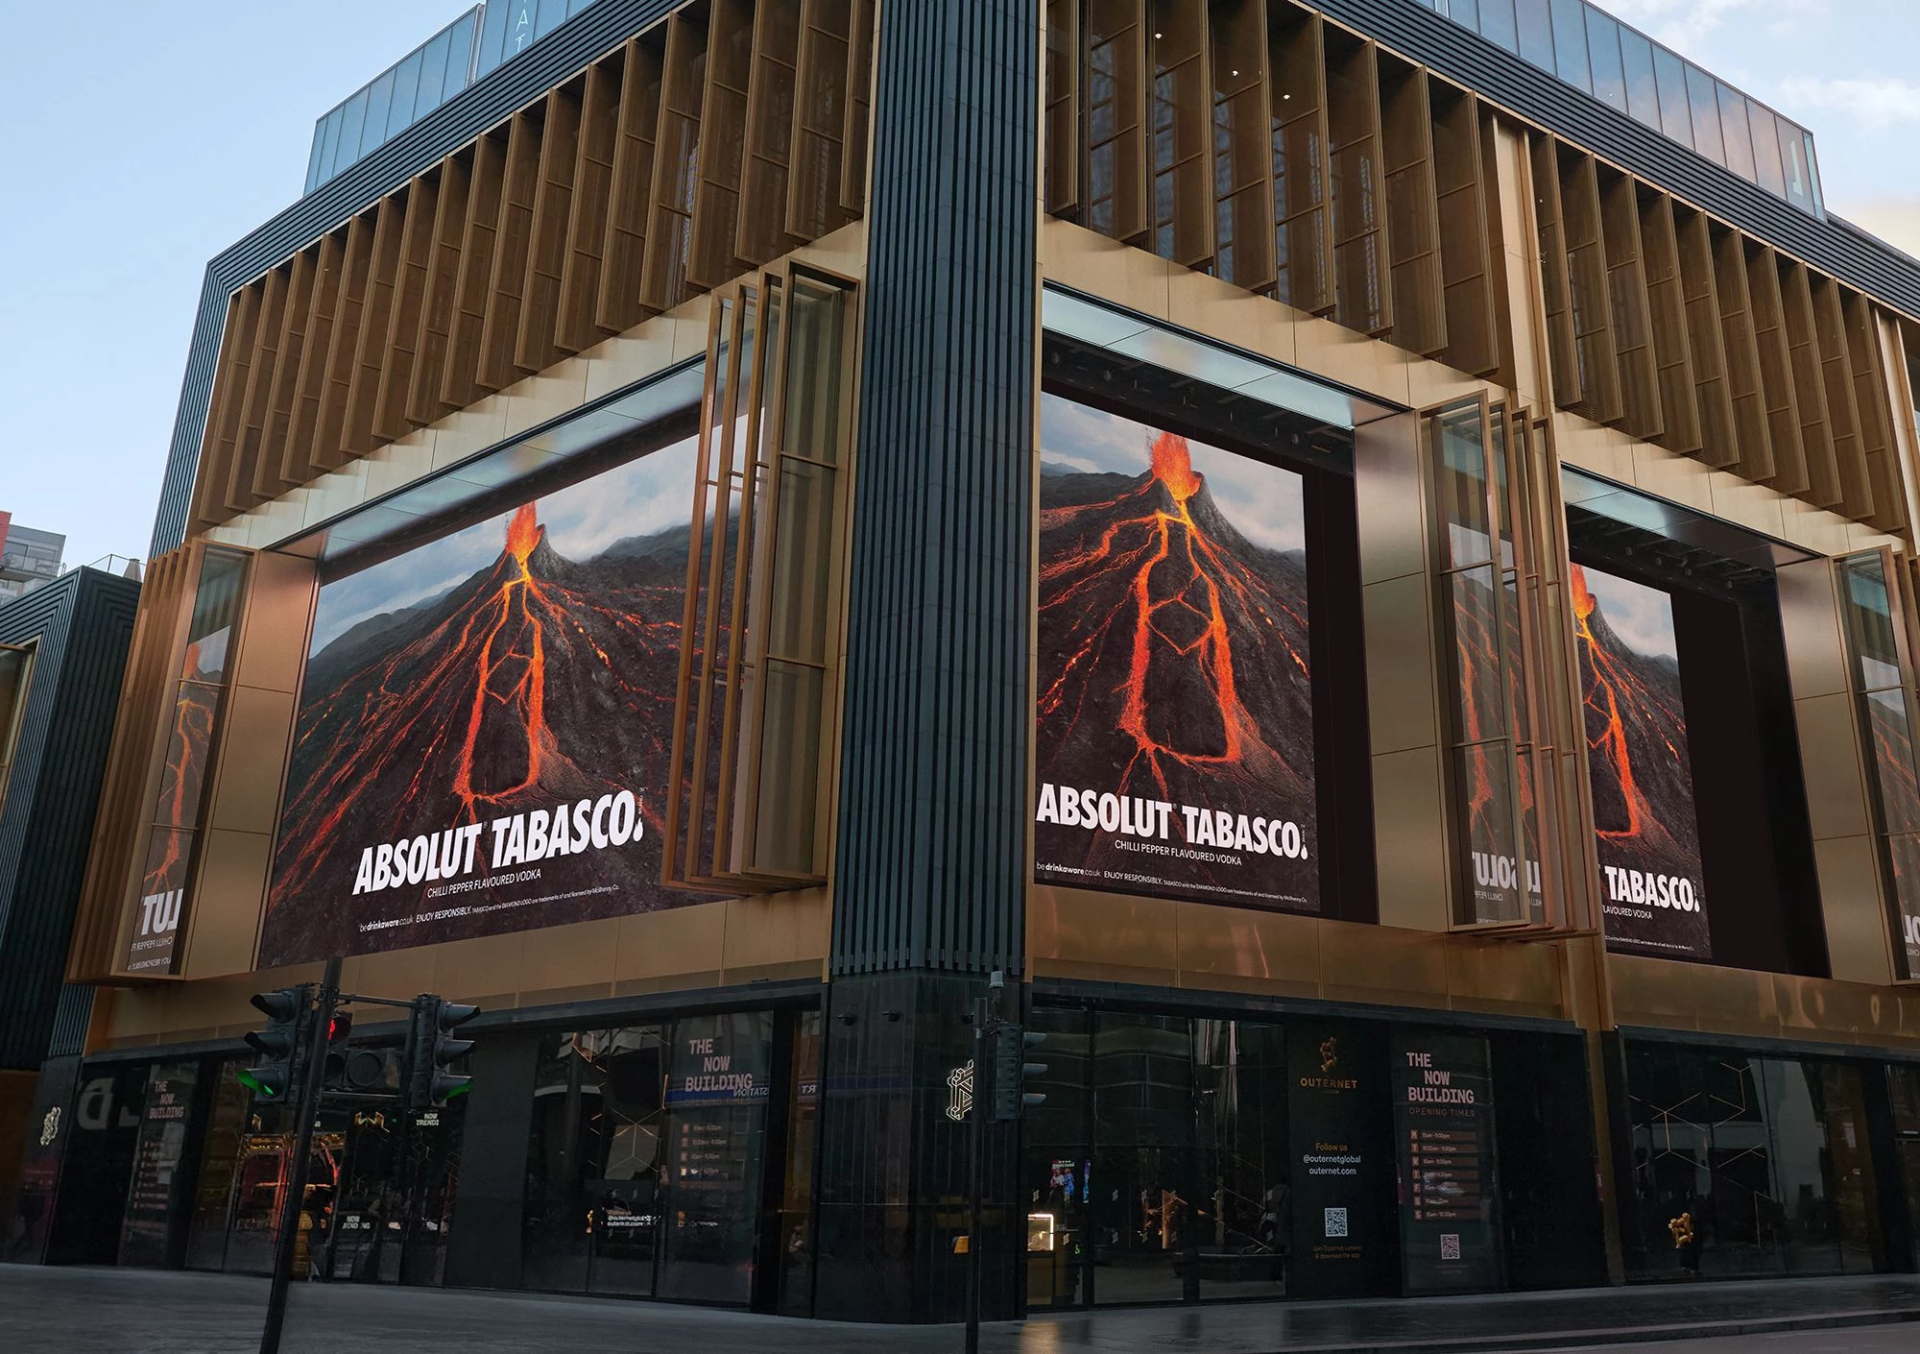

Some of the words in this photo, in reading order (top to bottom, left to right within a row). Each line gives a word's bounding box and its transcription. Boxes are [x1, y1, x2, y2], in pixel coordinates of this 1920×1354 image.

[1036, 783, 1172, 839] ABSOLUT
[352, 822, 483, 896] ABSOLUT
[1114, 840, 1140, 852] CHILLI
[1141, 844, 1170, 856] PEPPER
[1171, 848, 1215, 862] FLAVOURED
[1216, 854, 1242, 866] VODKA
[427, 886, 448, 898] CHILLI
[448, 882, 474, 894] PEPPER
[474, 874, 515, 890] FLAVOURED
[516, 868, 542, 882] VODKA
[1104, 870, 1124, 880] ENJOY
[1124, 873, 1163, 886] RESPONSIBLY.
[416, 912, 434, 922] ENJOY
[1633, 909, 1653, 920] VODKA
[689, 1038, 713, 1054] THE
[703, 1056, 730, 1072] NOW
[1406, 1052, 1432, 1067] THE
[685, 1073, 752, 1092] BUILDING
[1300, 1078, 1357, 1089] OUTERNET
[1424, 1070, 1450, 1085] NOW
[155, 1081, 169, 1092] THE
[1408, 1087, 1474, 1104] BUILDING
[149, 1106, 184, 1119] BUILDING
[1409, 1107, 1447, 1116] OPENING
[1450, 1108, 1475, 1117] TIMES
[1316, 1143, 1338, 1151] Follow
[1303, 1155, 1361, 1164] @outernetglobal
[1309, 1167, 1356, 1175] outernet.com
